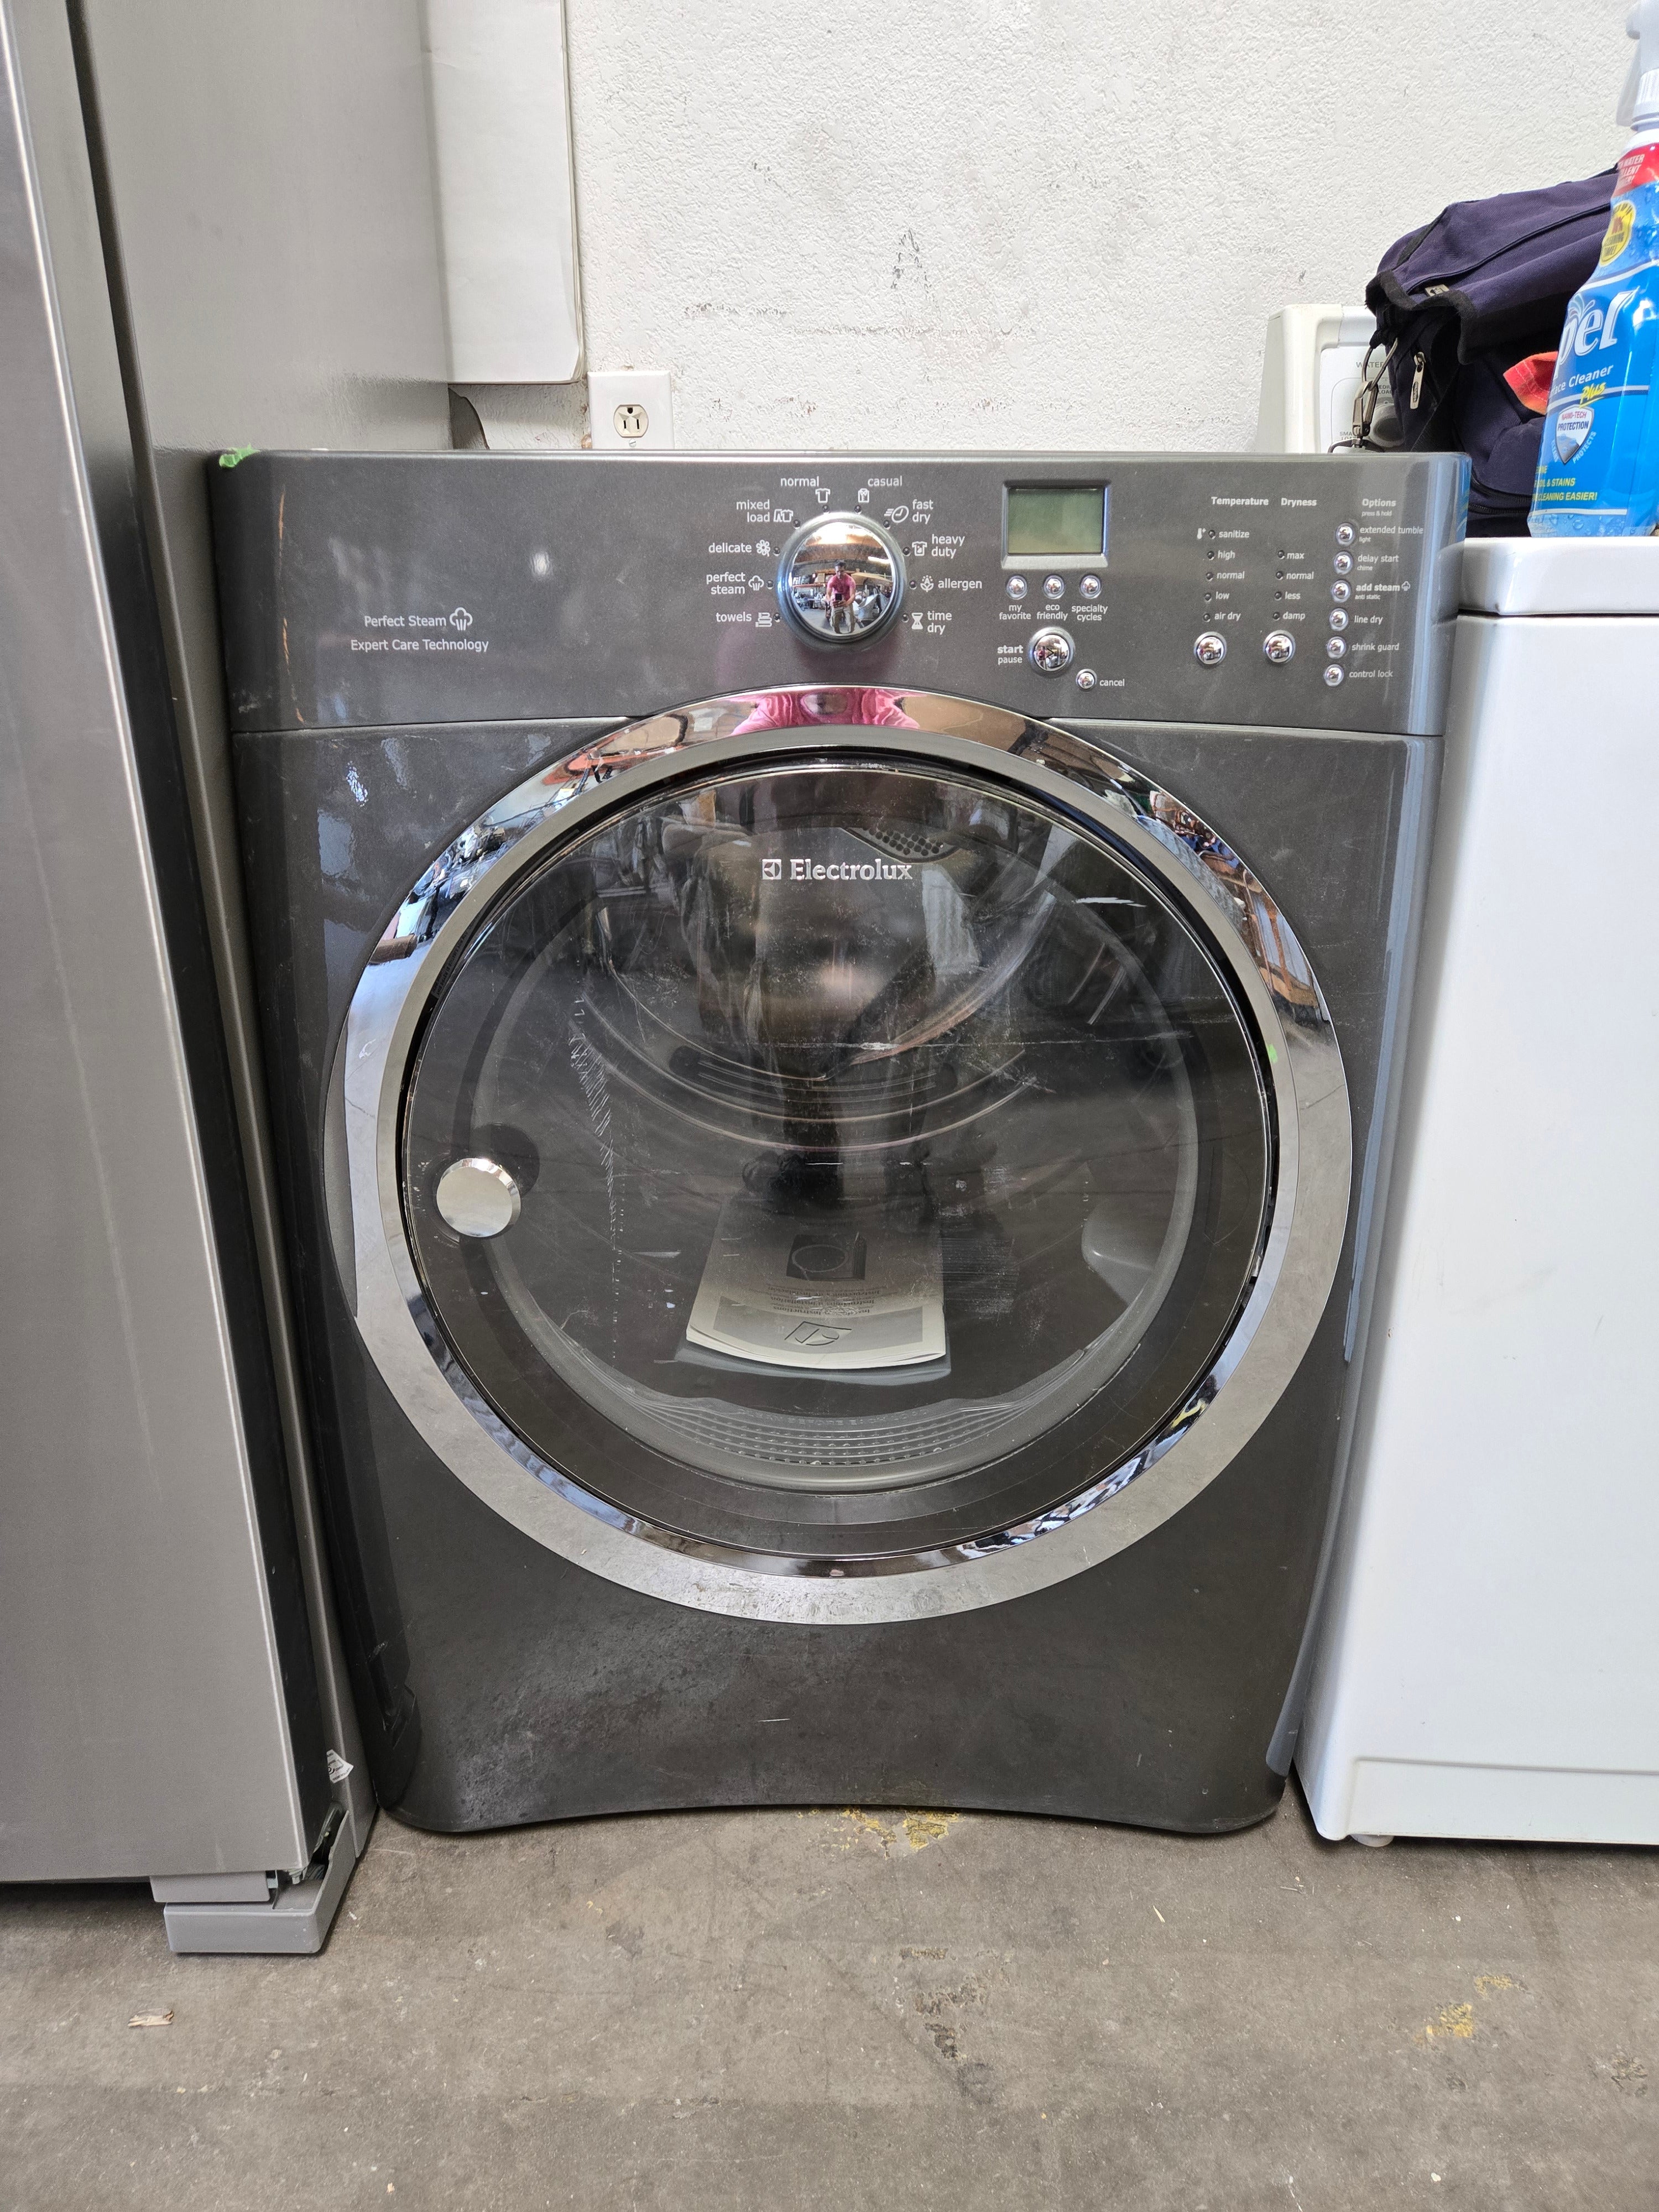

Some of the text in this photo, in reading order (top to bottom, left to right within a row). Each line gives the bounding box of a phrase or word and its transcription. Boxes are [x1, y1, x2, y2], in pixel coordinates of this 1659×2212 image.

[1553, 285, 1640, 379] pel
[1568, 364, 1614, 388] Cleaner
[1580, 382, 1606, 404] Plus
[1557, 421, 1589, 431] PROTECTION
[1572, 431, 1597, 464] PROTECTS
[780, 476, 819, 487] normal
[868, 476, 902, 487] casual
[1551, 478, 1575, 487] STAINS
[1566, 492, 1598, 500] EASIER!
[736, 499, 770, 510] mixed
[912, 499, 933, 510] fast
[1211, 497, 1269, 507] Temperature
[1281, 498, 1317, 508] Dryness
[1362, 498, 1396, 508] Options
[747, 512, 770, 522] load
[912, 512, 931, 524] dry
[1219, 530, 1250, 538] sanitize
[931, 534, 965, 547] heavy
[708, 542, 752, 553] delicate
[931, 546, 956, 559] duty
[1218, 550, 1235, 560] high
[1358, 554, 1379, 564] delay
[706, 572, 745, 585] perfect
[1217, 571, 1245, 579] normal
[1286, 571, 1314, 580] normal
[711, 585, 745, 594] steam
[938, 578, 982, 591] allergen
[1285, 591, 1301, 599] less
[1009, 604, 1022, 613] my
[1071, 604, 1108, 614] specialty
[364, 615, 446, 627] Perfect Steam
[716, 612, 752, 622] towels
[927, 611, 952, 621] time
[999, 612, 1031, 620] favorite
[1036, 612, 1068, 621] friendly
[1077, 613, 1102, 622] cycles
[1227, 612, 1241, 621] dry
[1282, 612, 1305, 621] damp
[1370, 615, 1383, 625] dry
[927, 623, 946, 635] dry
[351, 639, 489, 653] Expert Care Technology
[997, 645, 1024, 654] start
[1352, 643, 1400, 652] shrink guard
[998, 656, 1022, 665] pause
[1099, 679, 1125, 687] cancel
[790, 858, 912, 880] Electrolux
